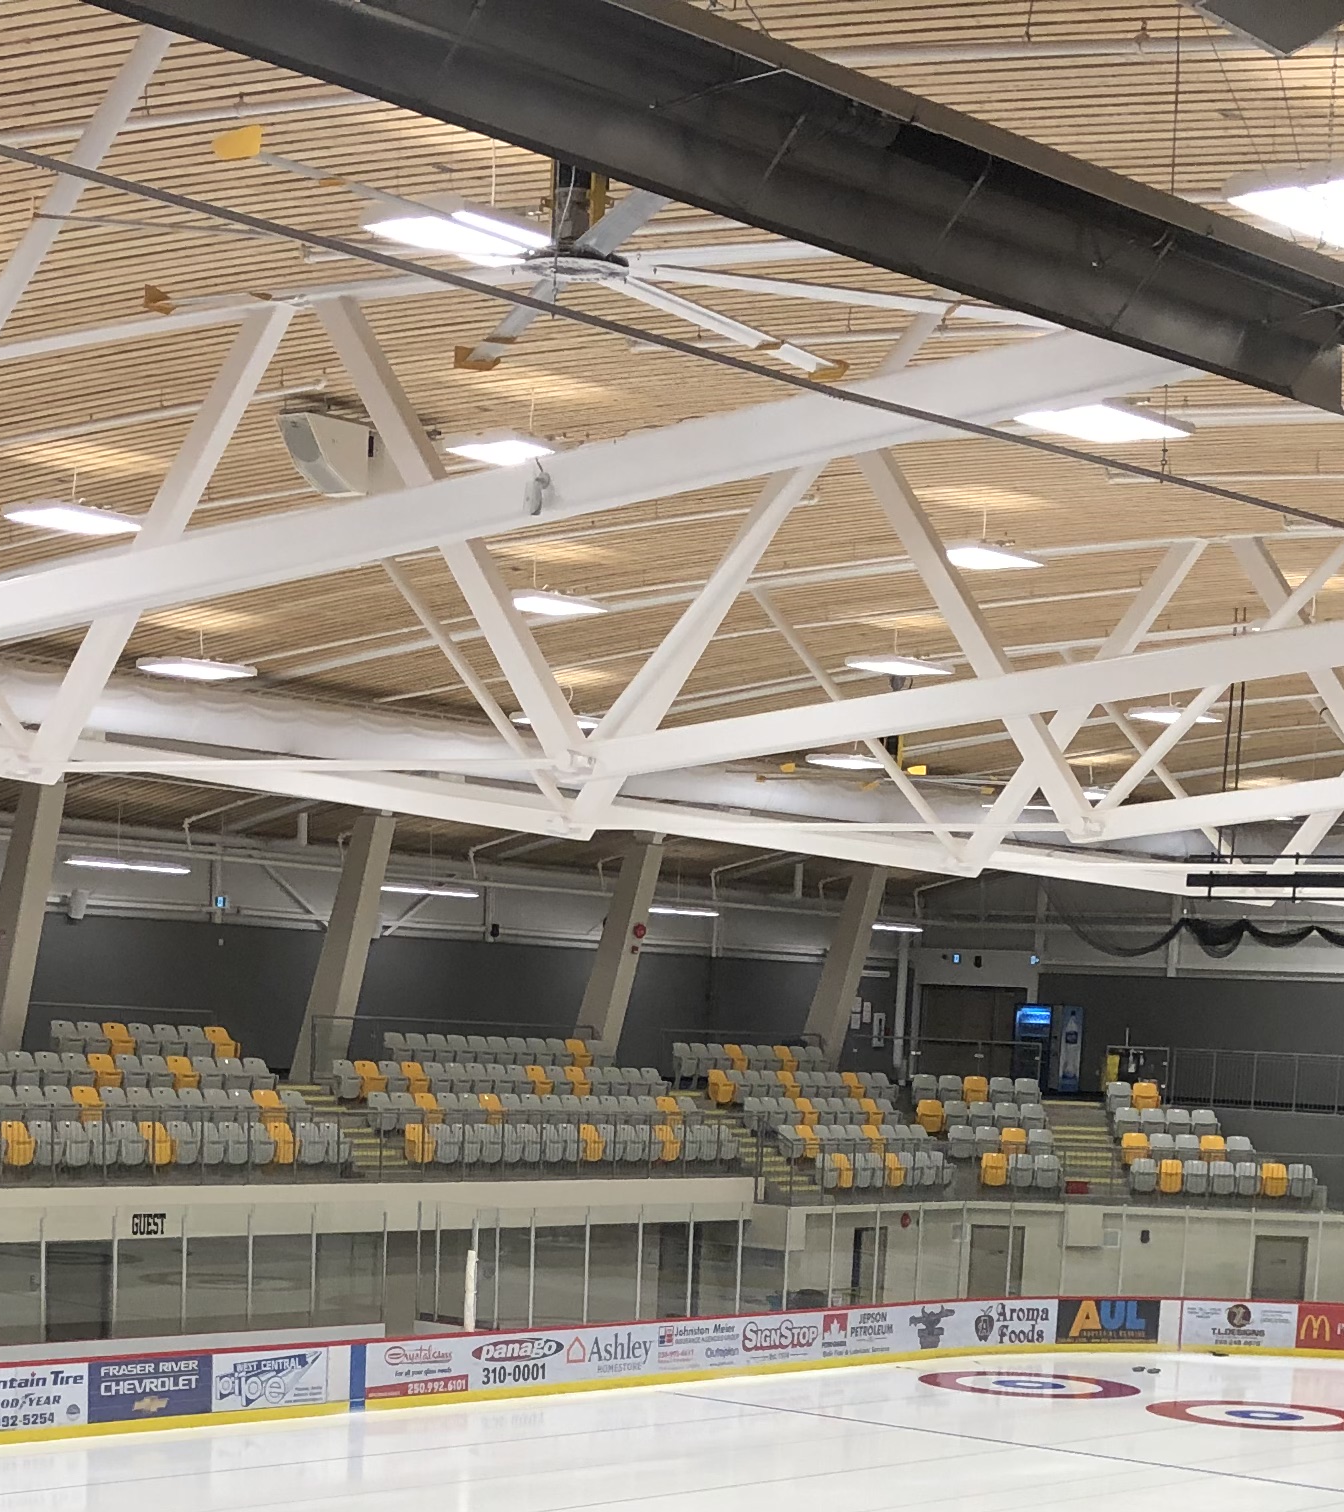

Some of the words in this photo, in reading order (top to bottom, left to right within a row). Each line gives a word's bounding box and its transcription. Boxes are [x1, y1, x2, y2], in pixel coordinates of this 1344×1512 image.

[131, 1213, 166, 1236] GUEST
[859, 1312, 888, 1325] JEPSON
[996, 1302, 1050, 1323] Aroma
[1068, 1300, 1146, 1338] AUL
[675, 1325, 710, 1337] Johnston
[713, 1323, 736, 1334] Meier
[850, 1323, 894, 1338] PETROLEUM
[998, 1324, 1045, 1345] Foods
[482, 1338, 557, 1361] panago
[588, 1332, 653, 1364] Ashley
[100, 1362, 155, 1377] FRASER
[159, 1360, 199, 1373] RIVER
[236, 1363, 257, 1373] WEST
[261, 1357, 302, 1371] CENTRAL
[482, 1363, 546, 1386] 310-0001
[597, 1362, 643, 1374] HOMESTORE
[50, 1370, 85, 1386] Tire
[100, 1374, 200, 1397] CHEVROLET
[407, 1379, 466, 1395] 250.992.6101
[215, 1372, 286, 1407] pipe
